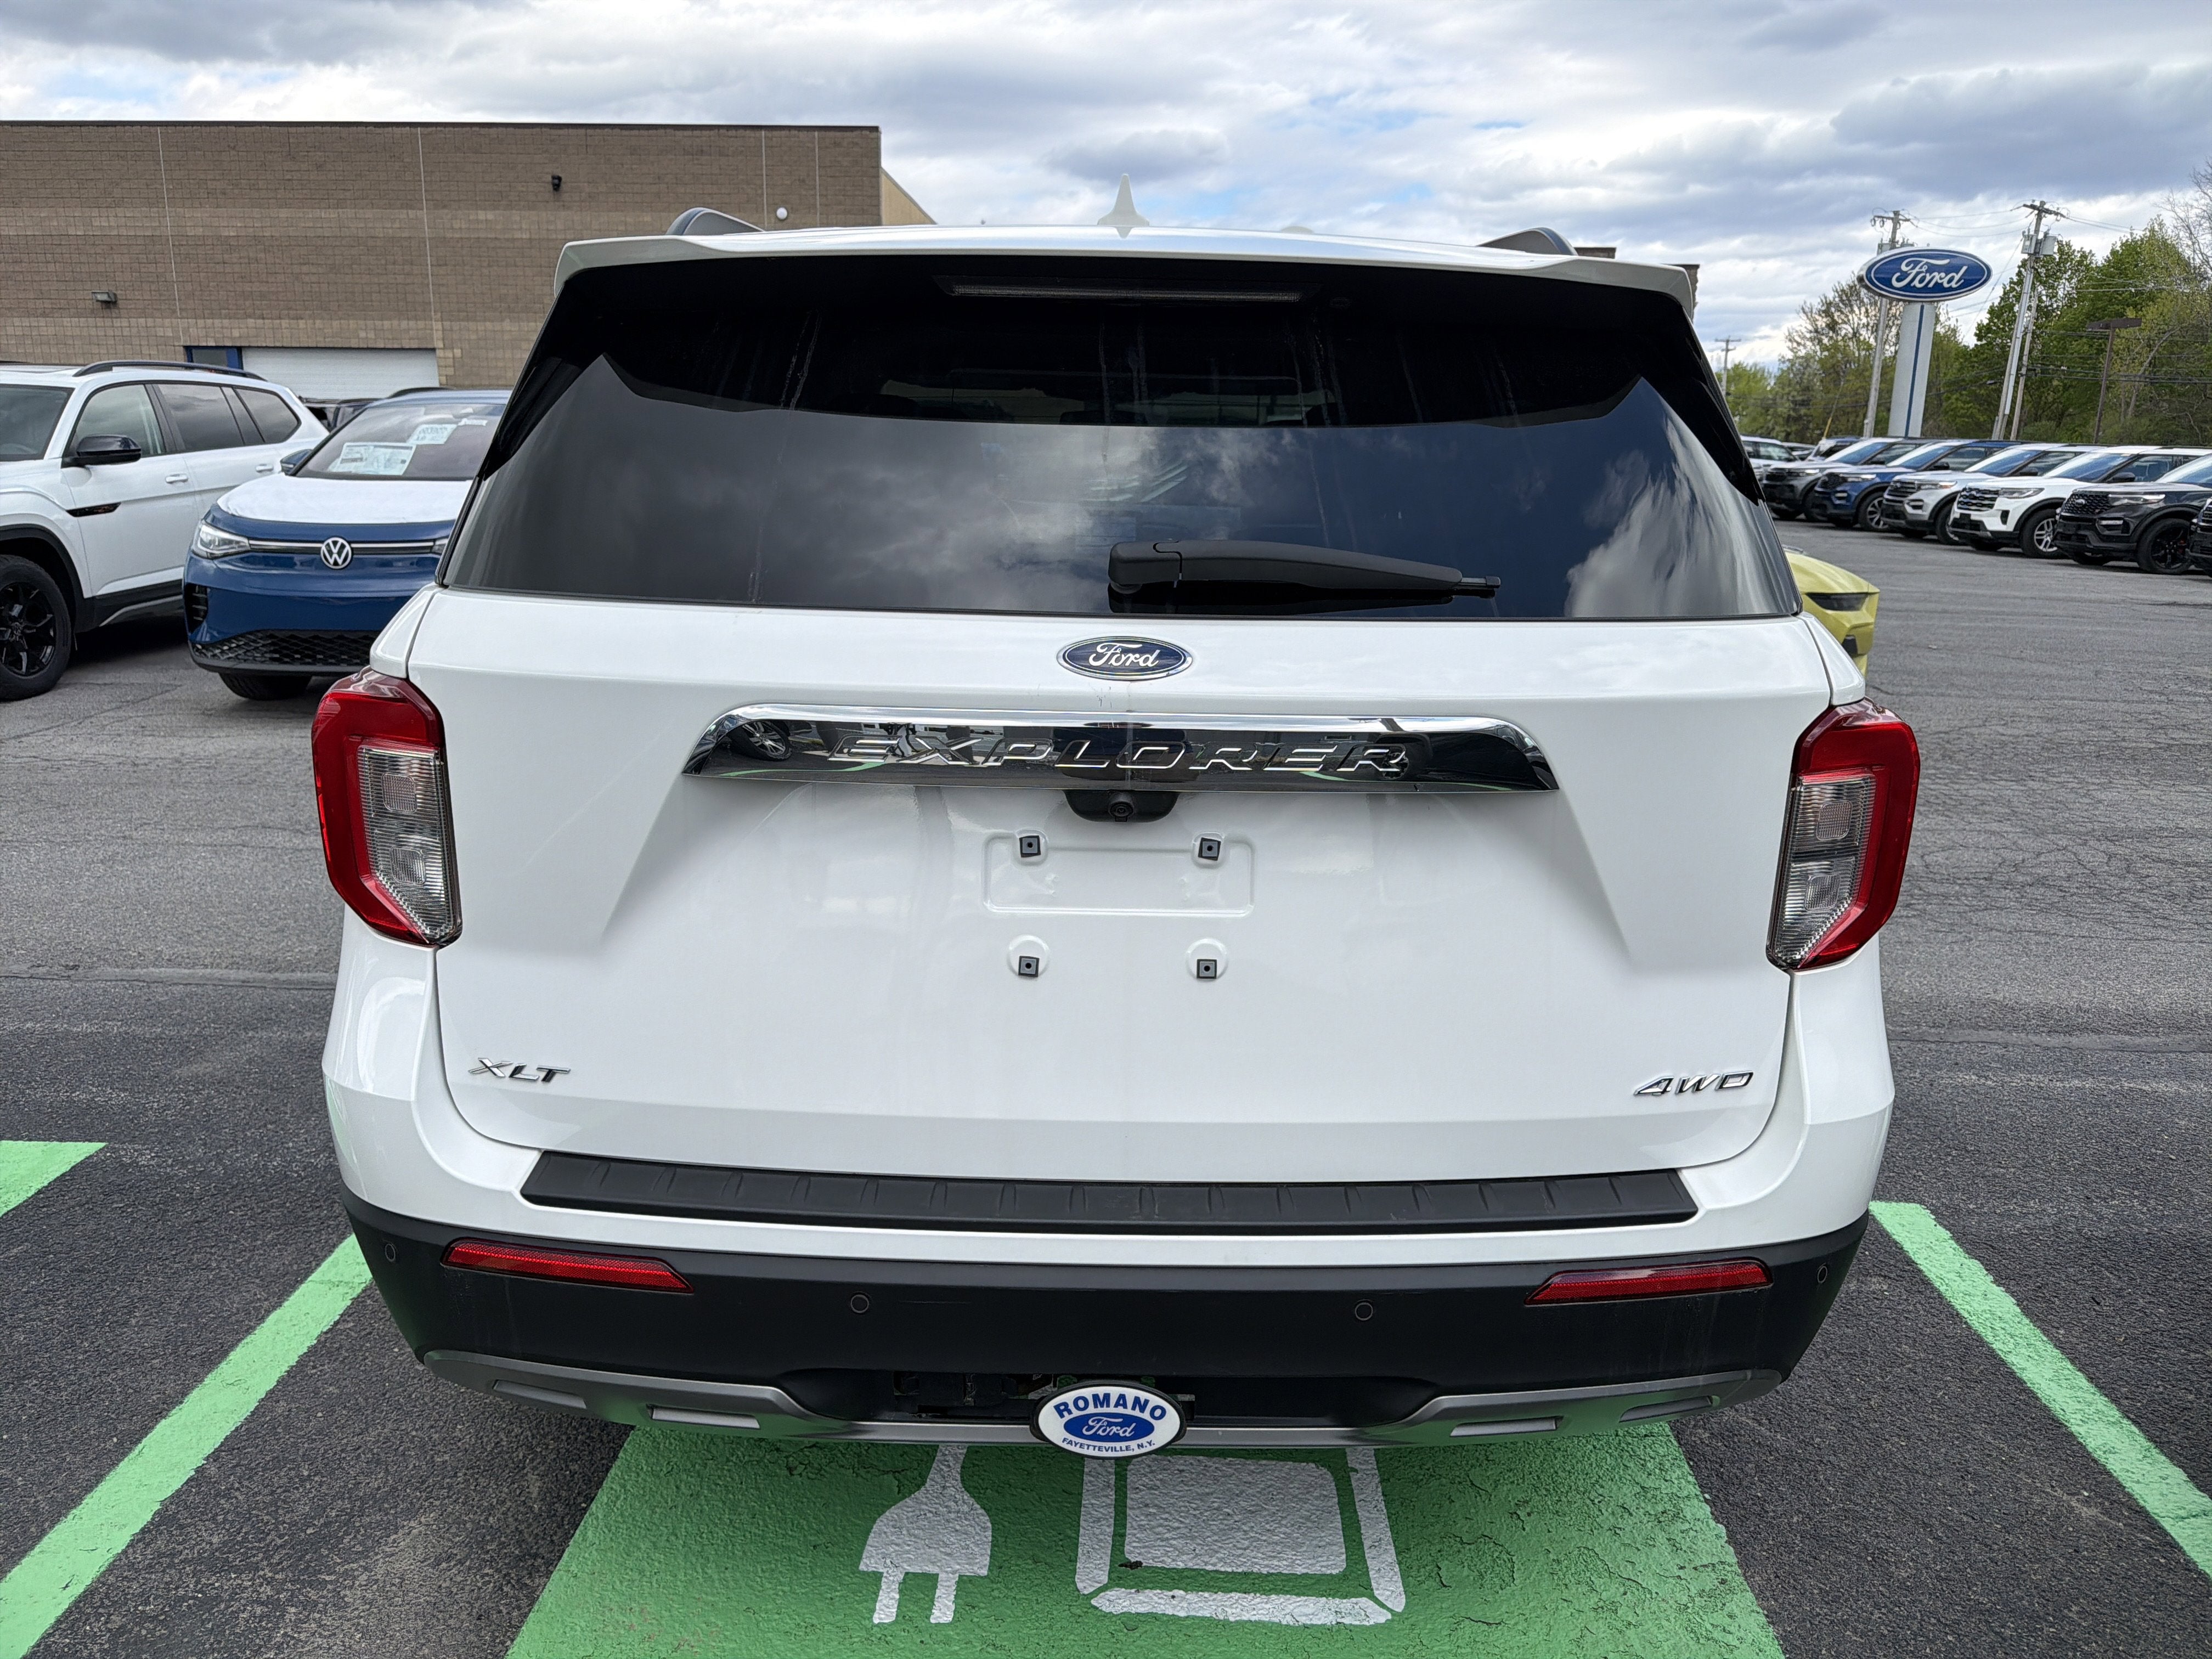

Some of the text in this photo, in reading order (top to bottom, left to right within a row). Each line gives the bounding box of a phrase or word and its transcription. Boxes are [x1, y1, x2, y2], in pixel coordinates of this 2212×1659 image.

[1892, 257, 1968, 289] Ford
[320, 537, 352, 569] VW
[1088, 642, 1161, 667] Ford
[827, 734, 1407, 772] EXPLORER
[468, 1057, 571, 1082] XLT
[1633, 1070, 1754, 1096] 4WD
[1053, 1392, 1167, 1421] ROMANO
[1082, 1416, 1137, 1437] Ford
[1062, 1437, 1155, 1452] FAYETTEVILLE, N.Y.
